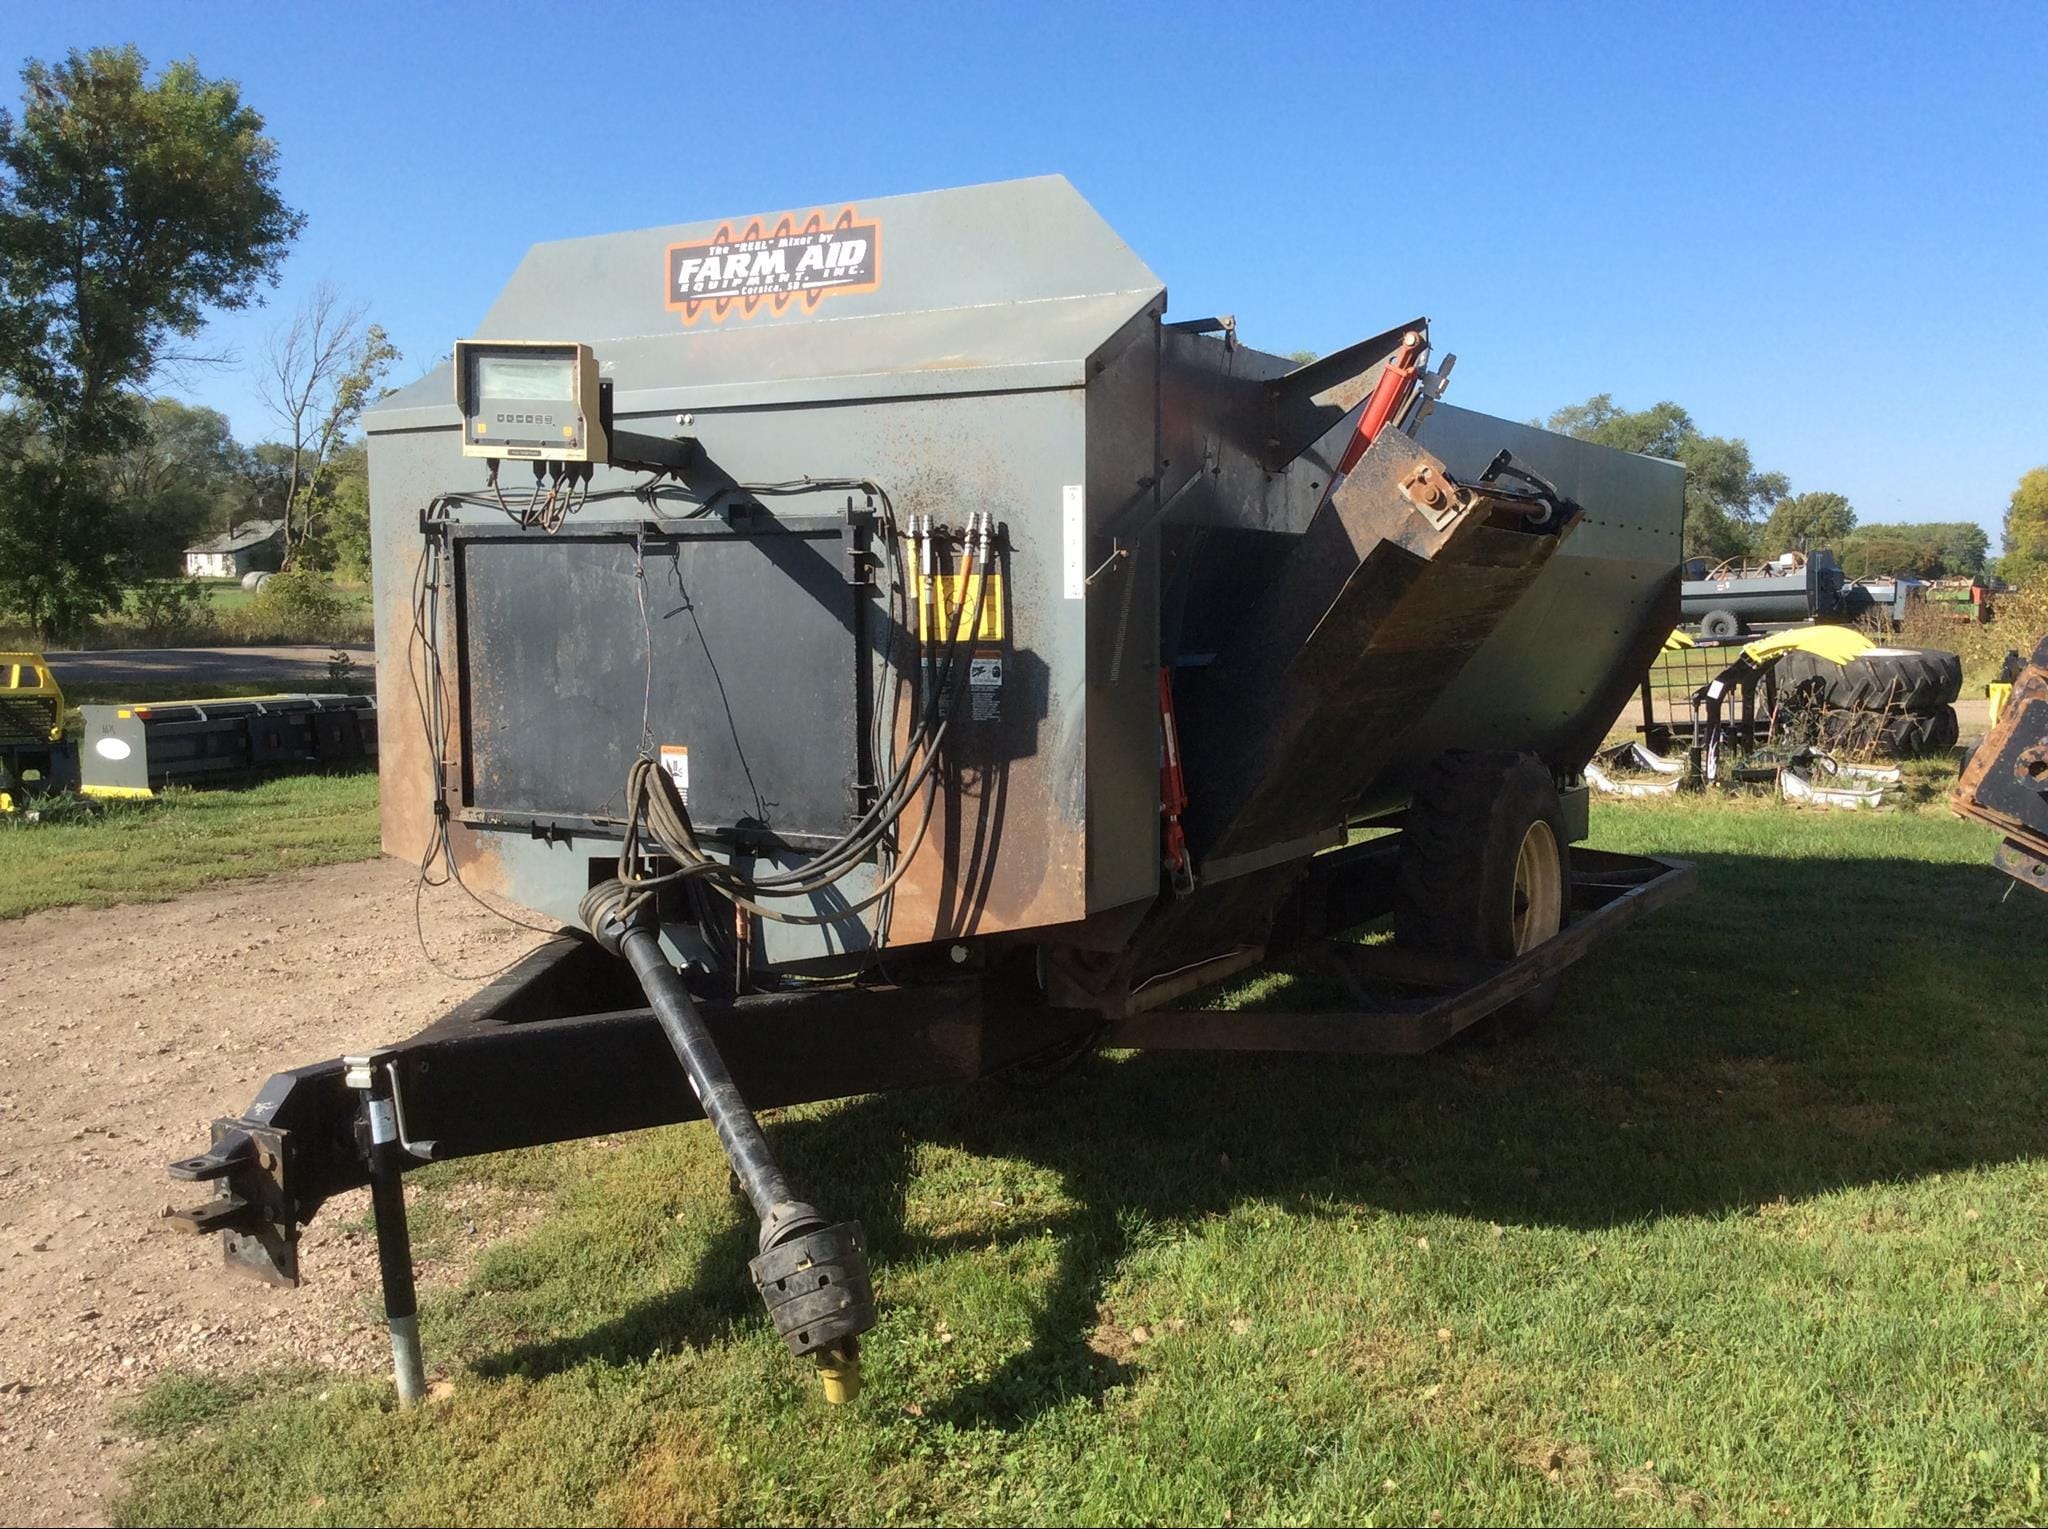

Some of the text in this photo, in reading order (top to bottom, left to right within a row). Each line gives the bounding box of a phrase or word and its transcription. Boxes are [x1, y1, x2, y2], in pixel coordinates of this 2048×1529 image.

[709, 246, 730, 256] The
[778, 236, 813, 248] Mixer
[819, 233, 834, 244] by
[678, 239, 867, 284] FARM AID
[823, 265, 865, 278] INC.
[787, 282, 800, 291] SD
